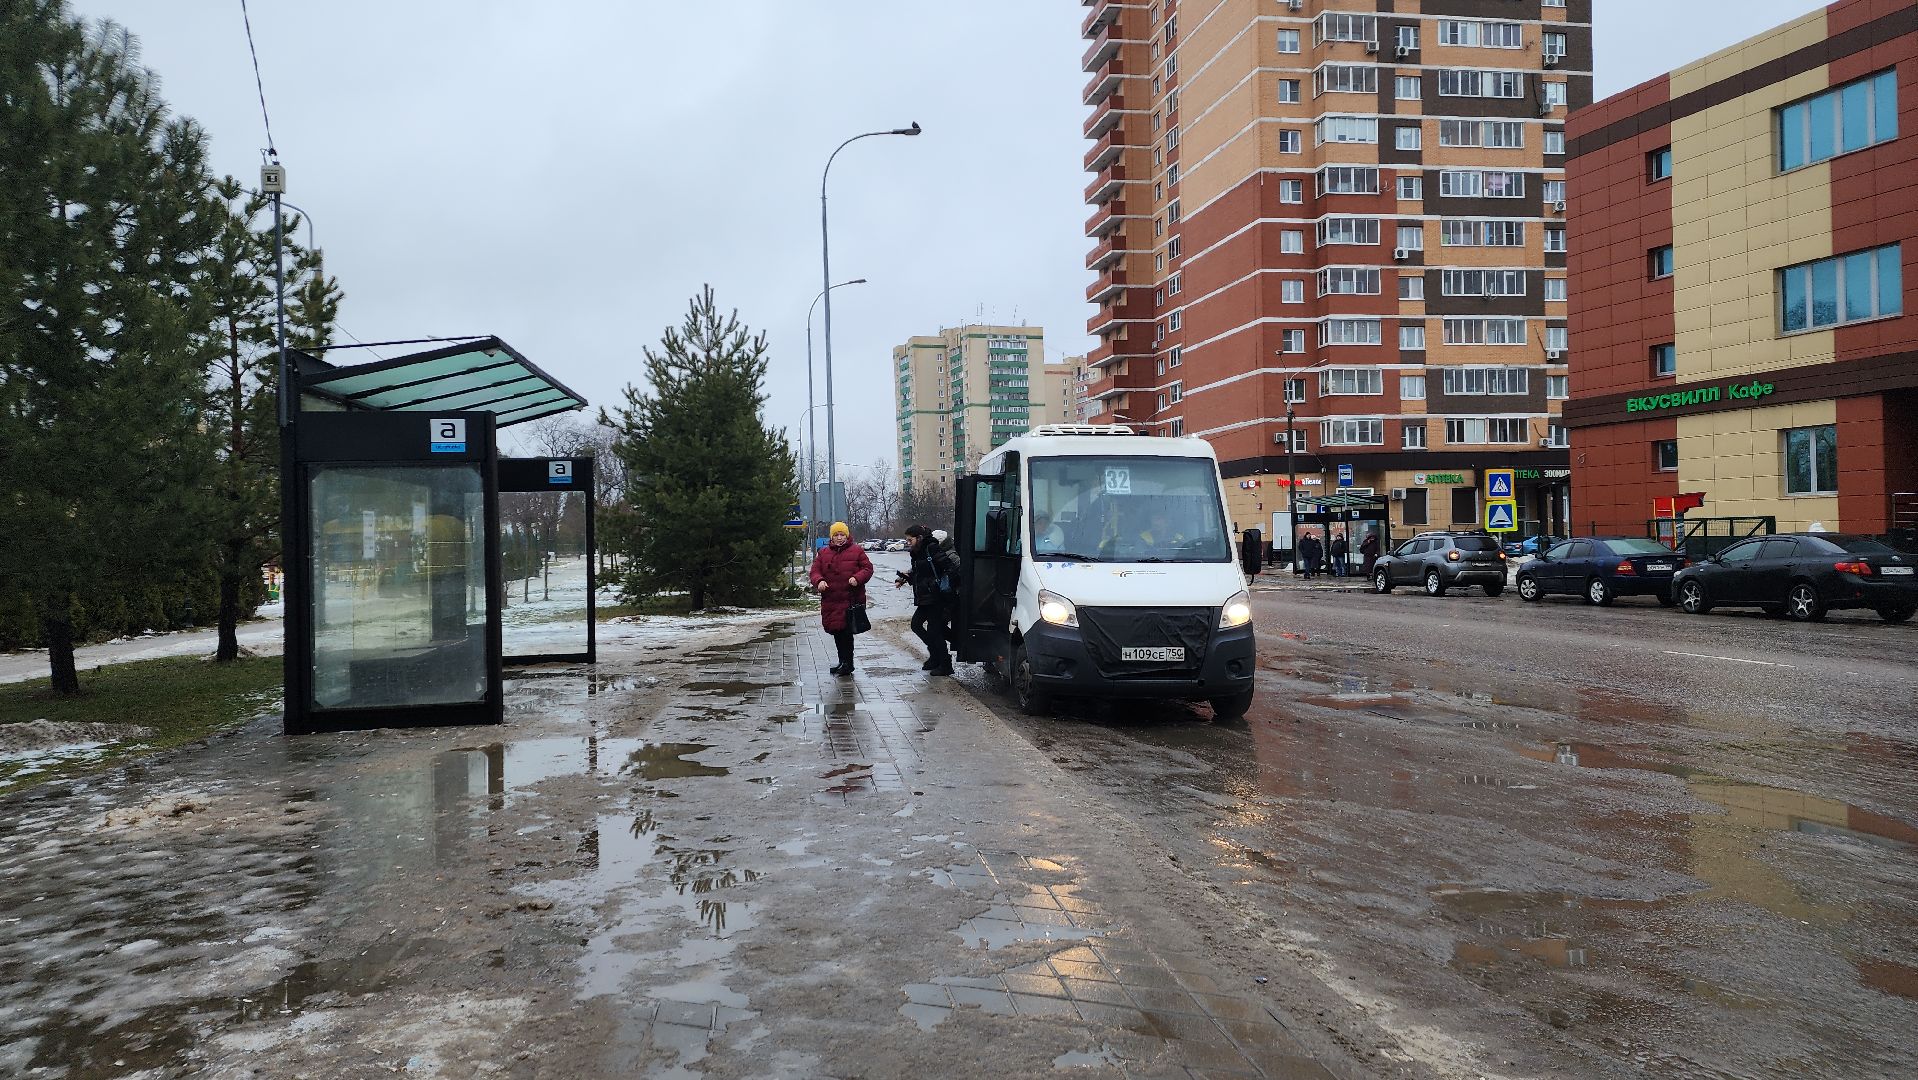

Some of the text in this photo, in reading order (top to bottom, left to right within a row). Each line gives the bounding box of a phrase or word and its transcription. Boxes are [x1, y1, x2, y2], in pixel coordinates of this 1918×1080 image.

[1626, 381, 1774, 413] ВКУСВИЛЛ Кафе
[1106, 470, 1129, 488] 32
[1426, 473, 1464, 484] АПТЕКА
